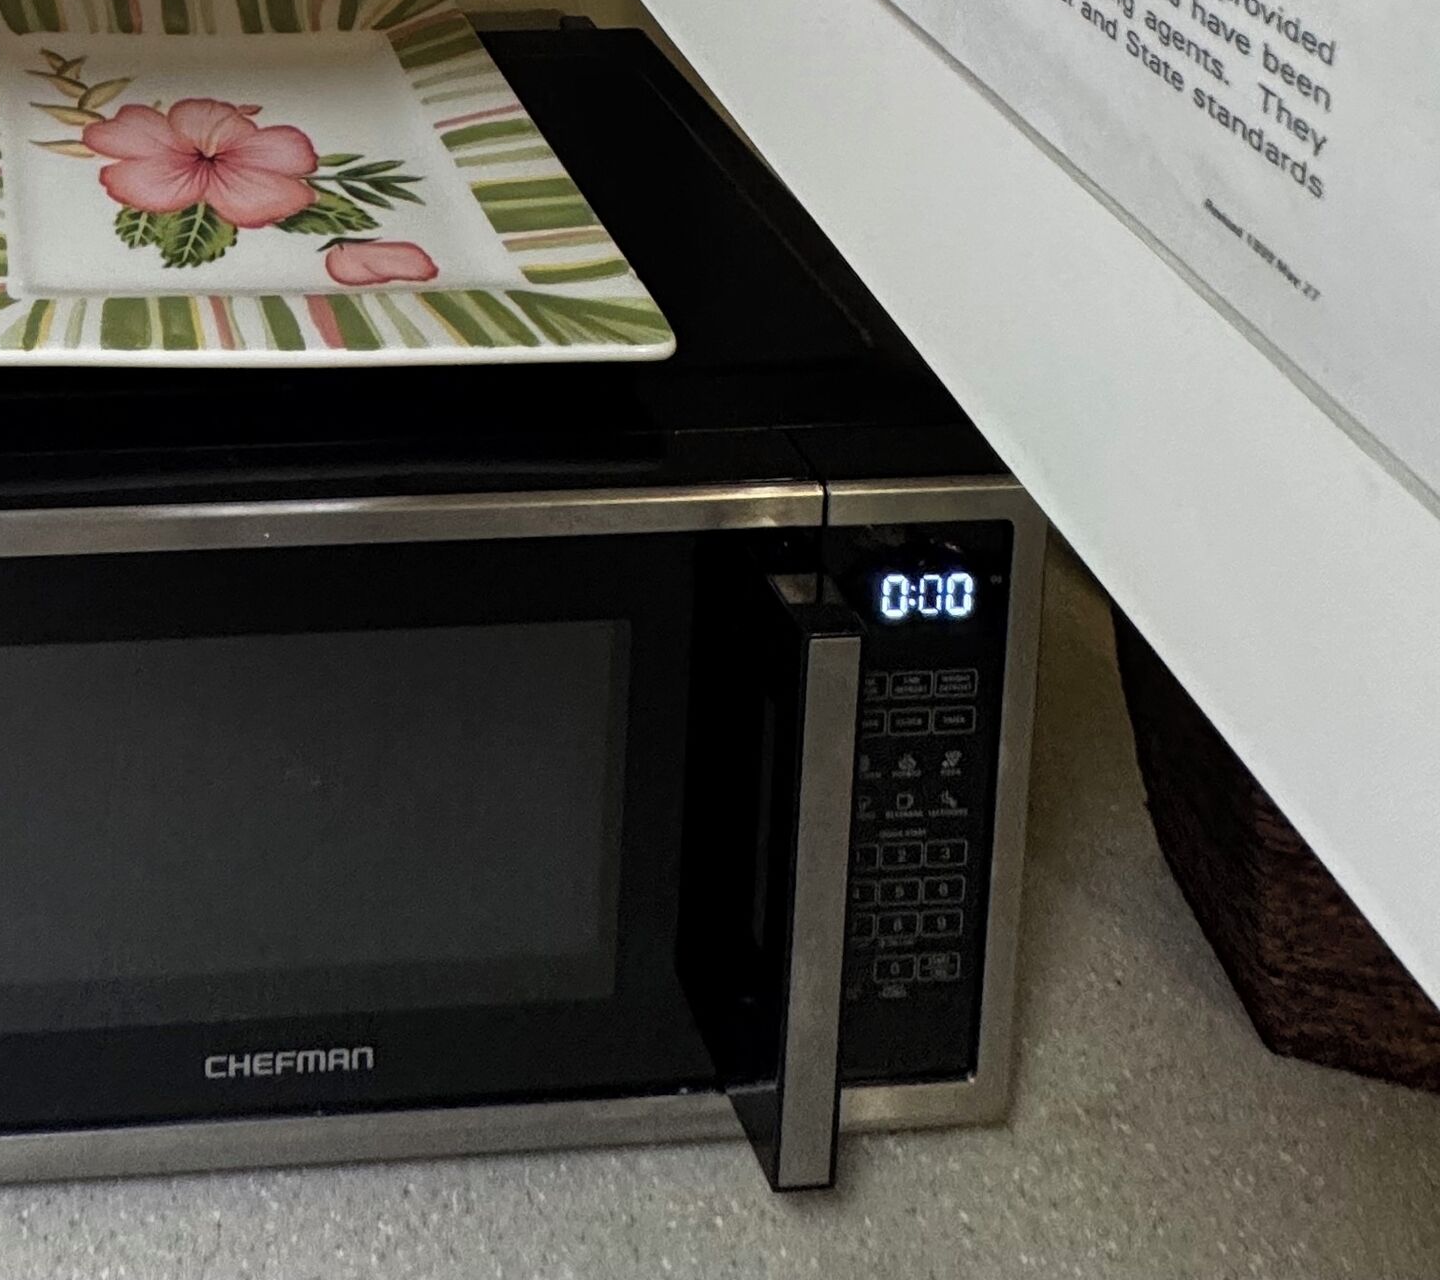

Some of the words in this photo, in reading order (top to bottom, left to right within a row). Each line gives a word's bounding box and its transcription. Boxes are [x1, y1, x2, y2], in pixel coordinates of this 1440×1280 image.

[1080, 1, 1118, 41] and
[1125, 29, 1184, 92] State
[1193, 87, 1324, 199] standards
[1144, 9, 1230, 87] agents.
[1258, 82, 1327, 157] They
[1262, 42, 1331, 113] been
[881, 572, 973, 617] 0:00
[204, 1045, 375, 1079] CHEFMAN
